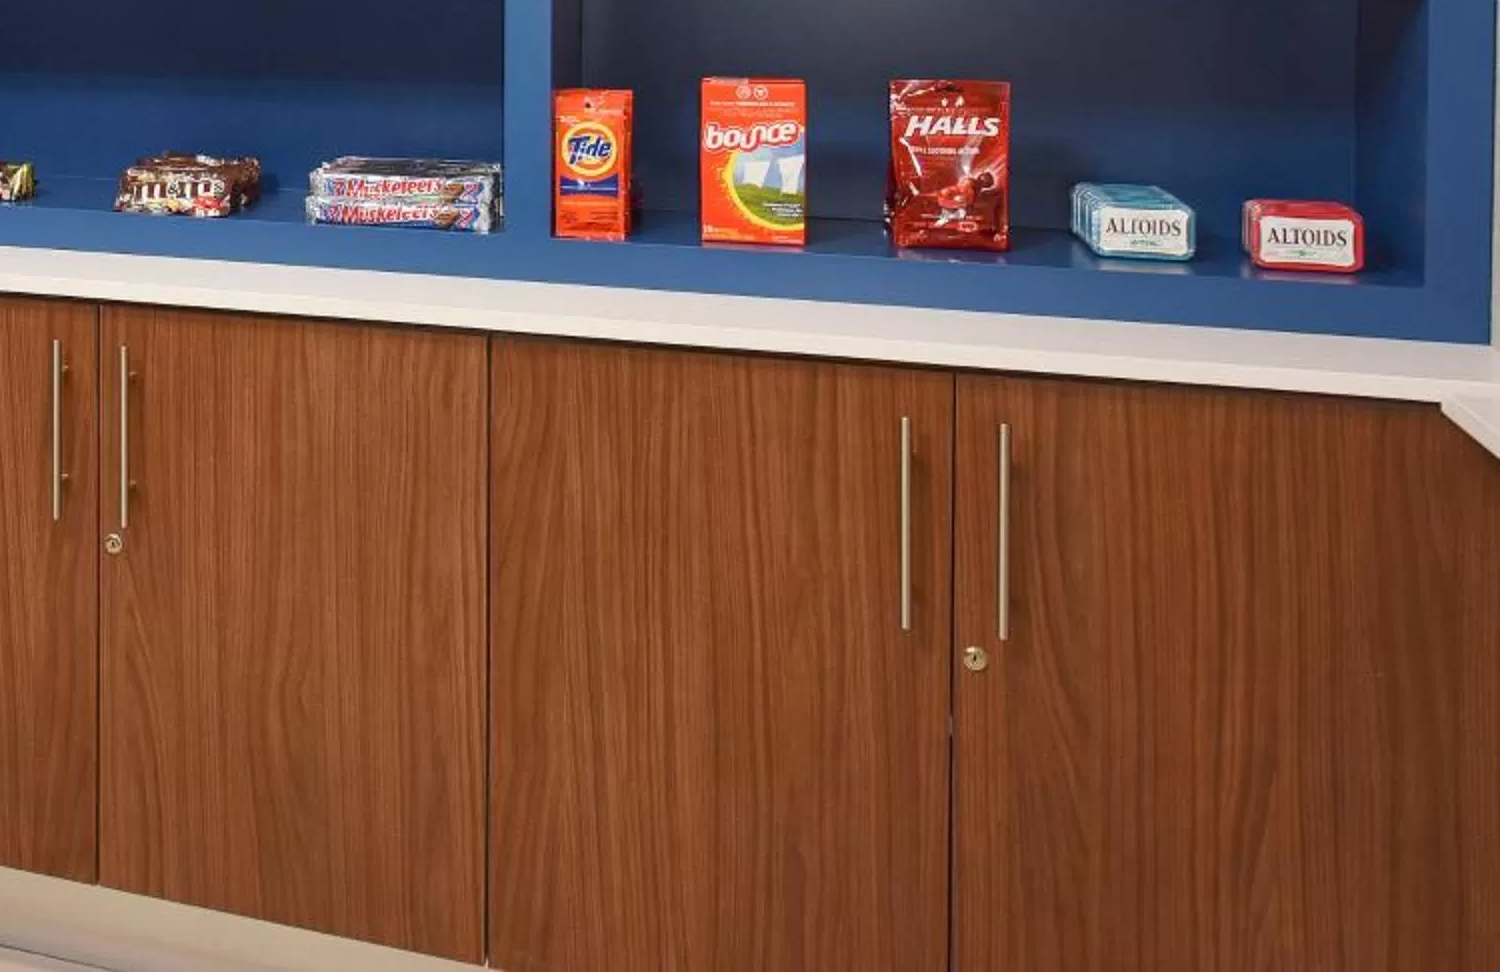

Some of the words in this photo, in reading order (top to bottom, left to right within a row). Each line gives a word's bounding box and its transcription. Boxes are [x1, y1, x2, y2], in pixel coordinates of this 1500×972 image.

[706, 122, 798, 150] bounce
[903, 115, 1001, 137] HALLS
[568, 135, 612, 165] Tide
[1105, 216, 1182, 237] ALTOIDS
[1267, 227, 1348, 248] ALTOIDS
